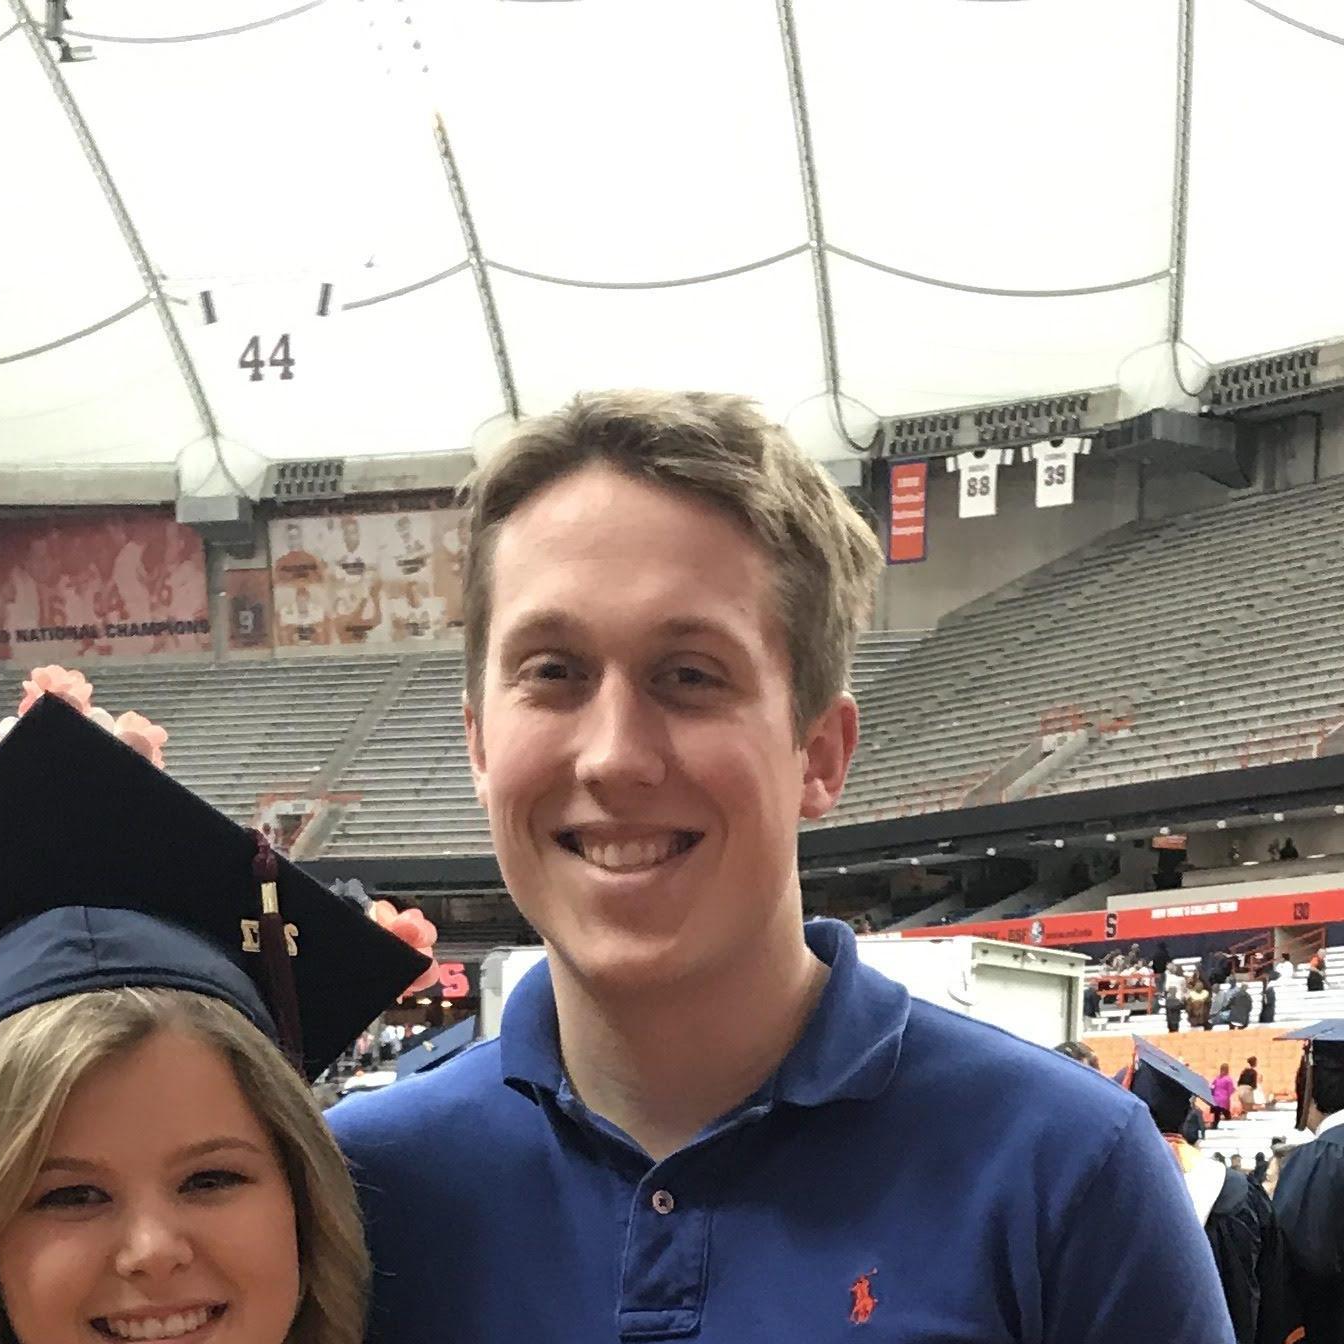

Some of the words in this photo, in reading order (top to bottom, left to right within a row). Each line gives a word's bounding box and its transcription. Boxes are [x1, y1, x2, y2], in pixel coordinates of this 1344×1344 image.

[238, 333, 295, 381] 44
[967, 476, 990, 497] 88
[1044, 464, 1066, 486] 39
[15, 624, 99, 642] NATIONAL
[106, 619, 211, 638] CHAMPIONS
[1106, 912, 1117, 938] S
[439, 962, 470, 999] S
